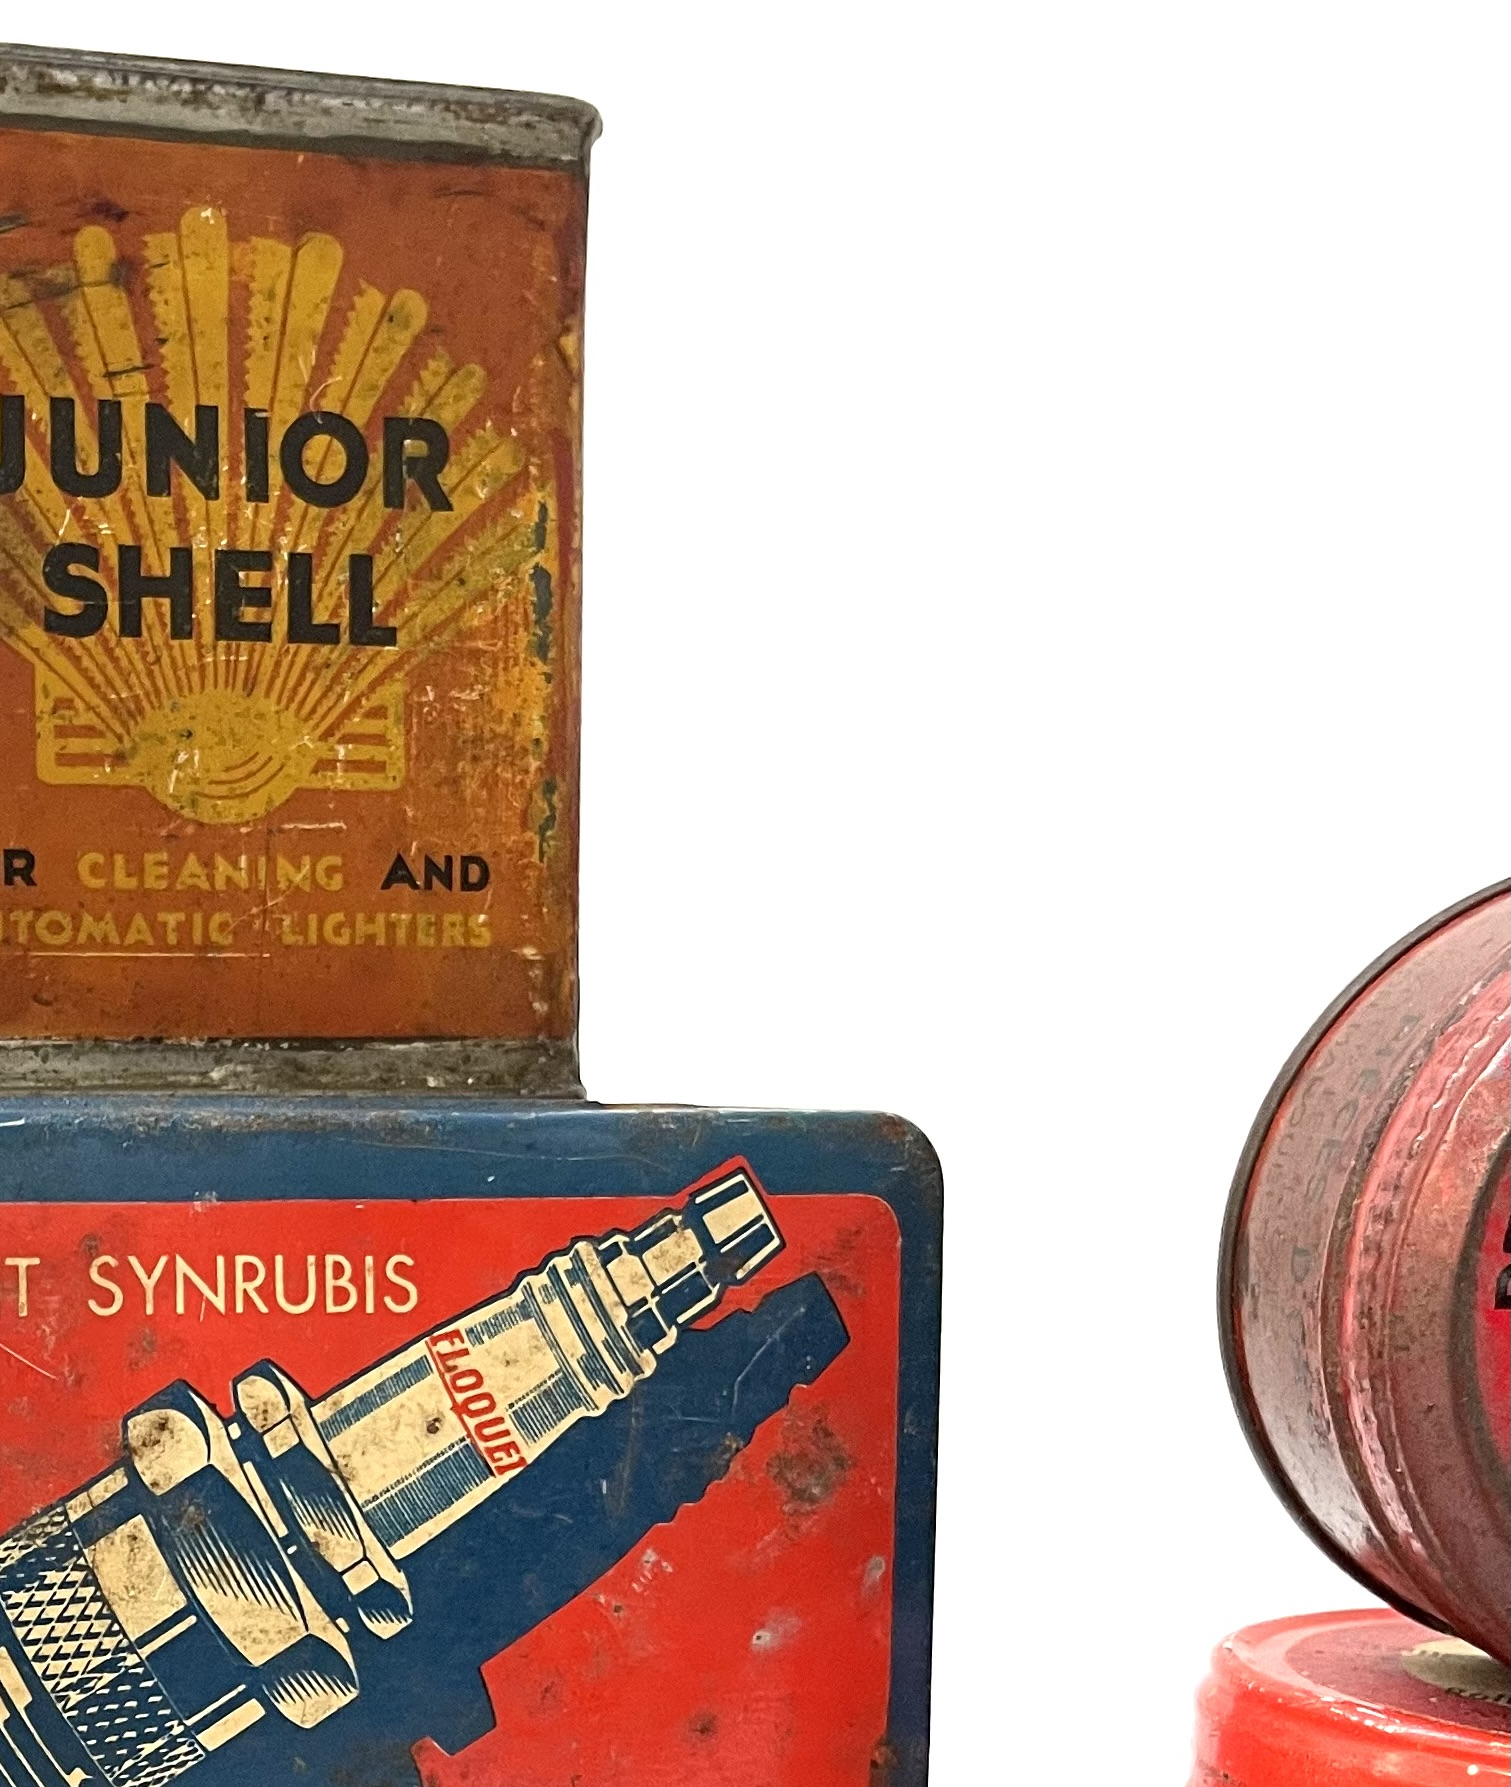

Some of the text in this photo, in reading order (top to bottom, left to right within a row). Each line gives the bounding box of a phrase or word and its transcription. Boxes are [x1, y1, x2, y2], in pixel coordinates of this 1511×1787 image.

[42, 543, 399, 648] SHELL
[76, 851, 345, 892] CLEANING
[380, 853, 492, 893] AND
[281, 910, 493, 949] LIGHTERS
[87, 1254, 419, 1318] SYNRUBIS
[427, 1328, 528, 1476] FLOQUET
